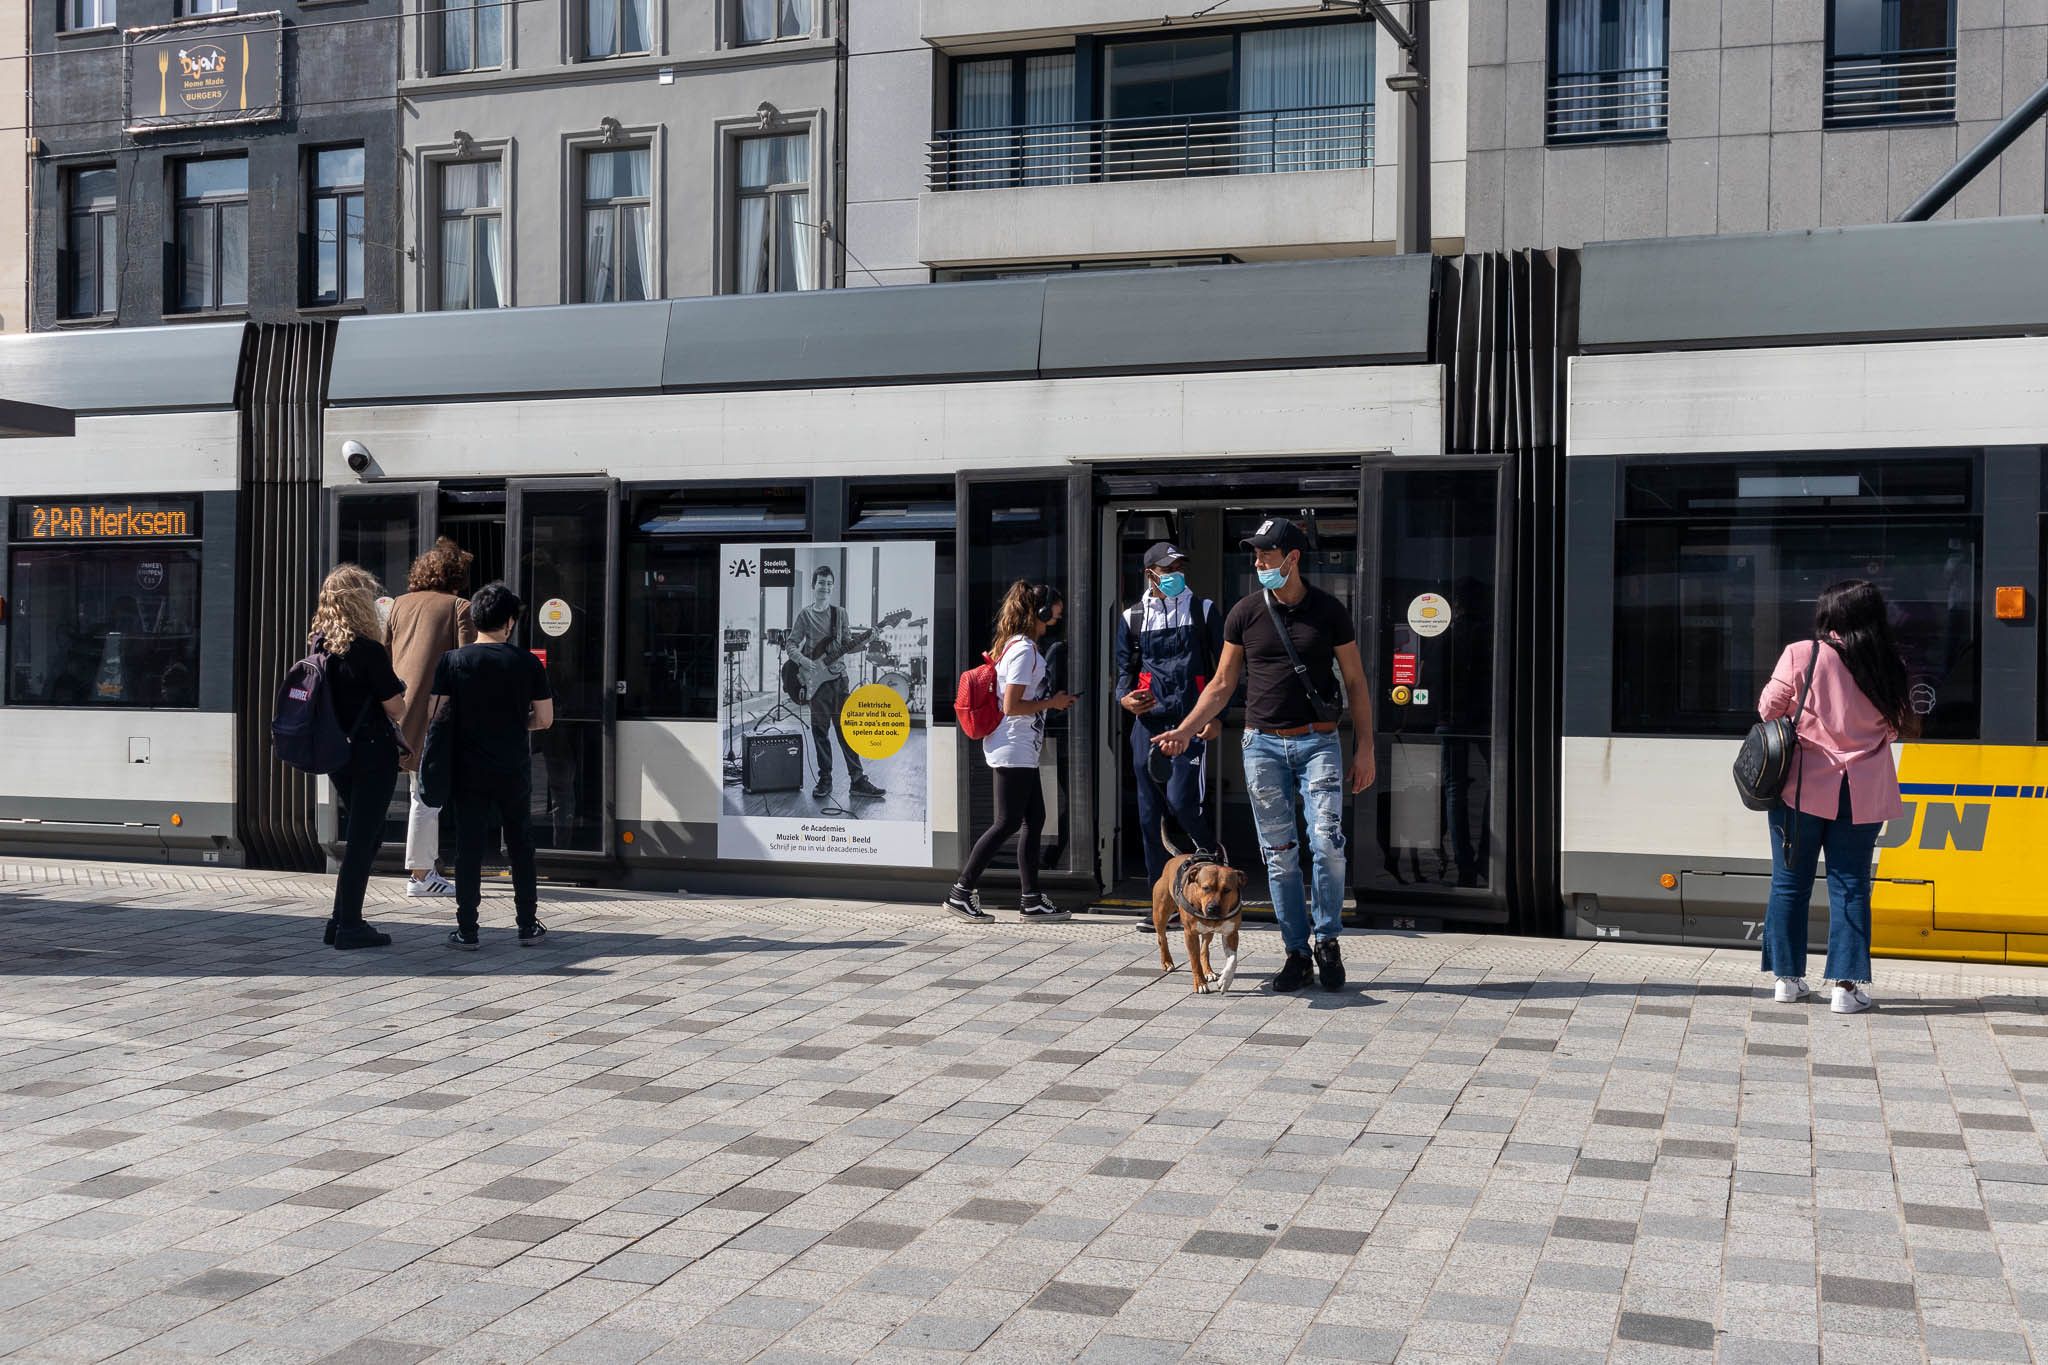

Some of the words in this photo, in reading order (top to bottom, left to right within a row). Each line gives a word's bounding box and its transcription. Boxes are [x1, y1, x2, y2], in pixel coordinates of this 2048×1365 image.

[184, 80, 203, 88] Home
[205, 78, 224, 86] Made
[186, 91, 222, 101] BURGERS
[33, 507, 46, 537] 2
[51, 507, 83, 536] P+R
[90, 505, 186, 536] Merksem
[763, 560, 788, 568] Stedelijk
[811, 824, 846, 832] Academies
[776, 833, 800, 841] Muziek
[804, 834, 826, 842] Woord
[831, 835, 848, 843] Dans
[769, 843, 790, 852] Schrijf
[790, 843, 797, 852] je
[826, 845, 878, 854] deacademies.be
[1742, 921, 1764, 940] 72
